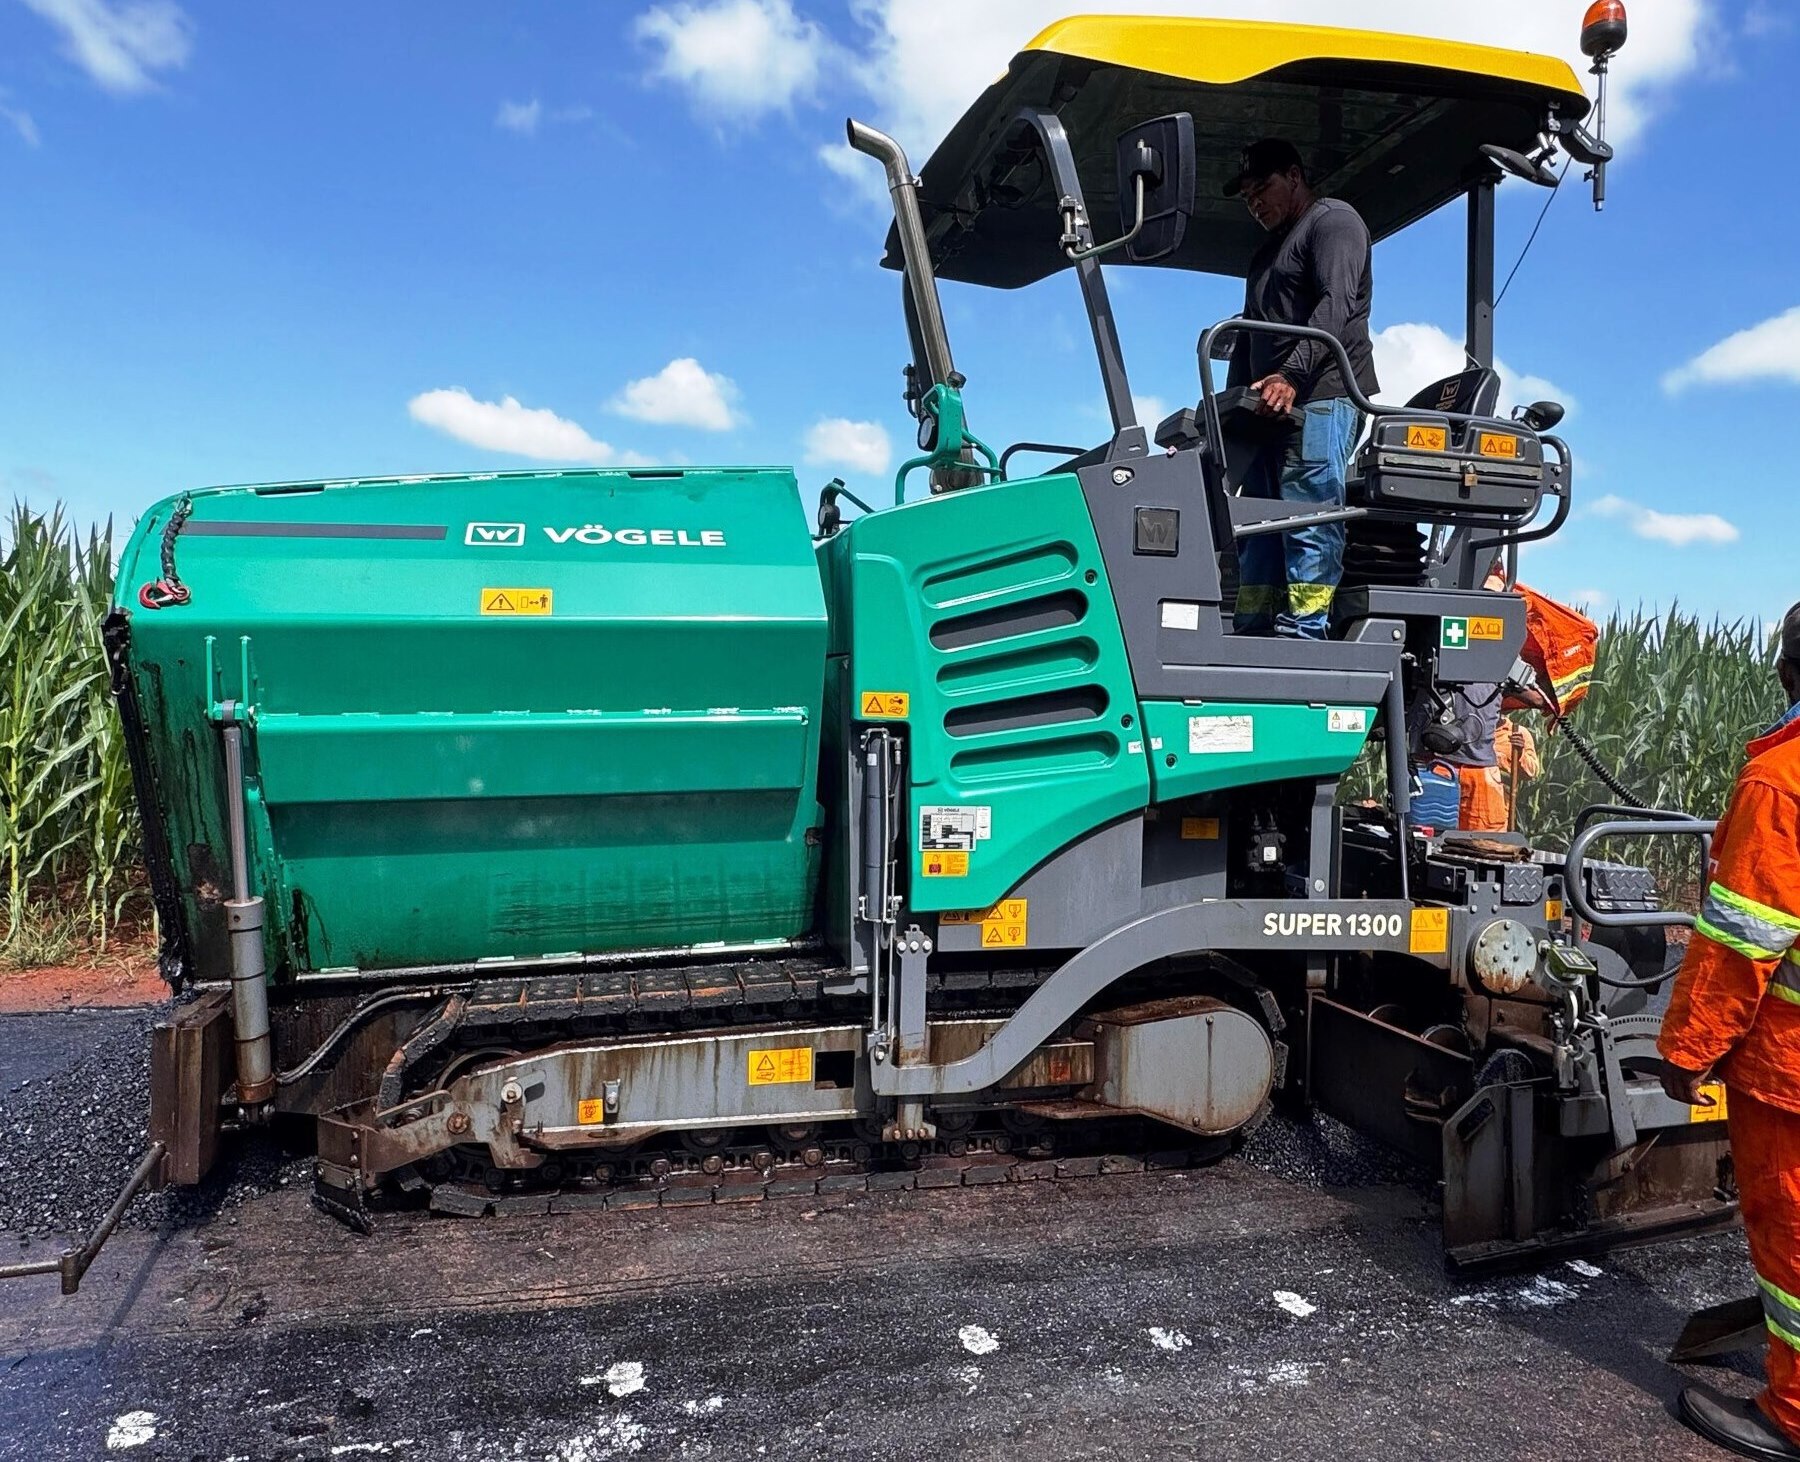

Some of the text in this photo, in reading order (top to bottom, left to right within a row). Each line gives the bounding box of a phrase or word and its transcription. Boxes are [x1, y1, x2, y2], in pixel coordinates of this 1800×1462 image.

[543, 523, 727, 547] VÖGELE
[1262, 912, 1403, 937] SUPER 1300
